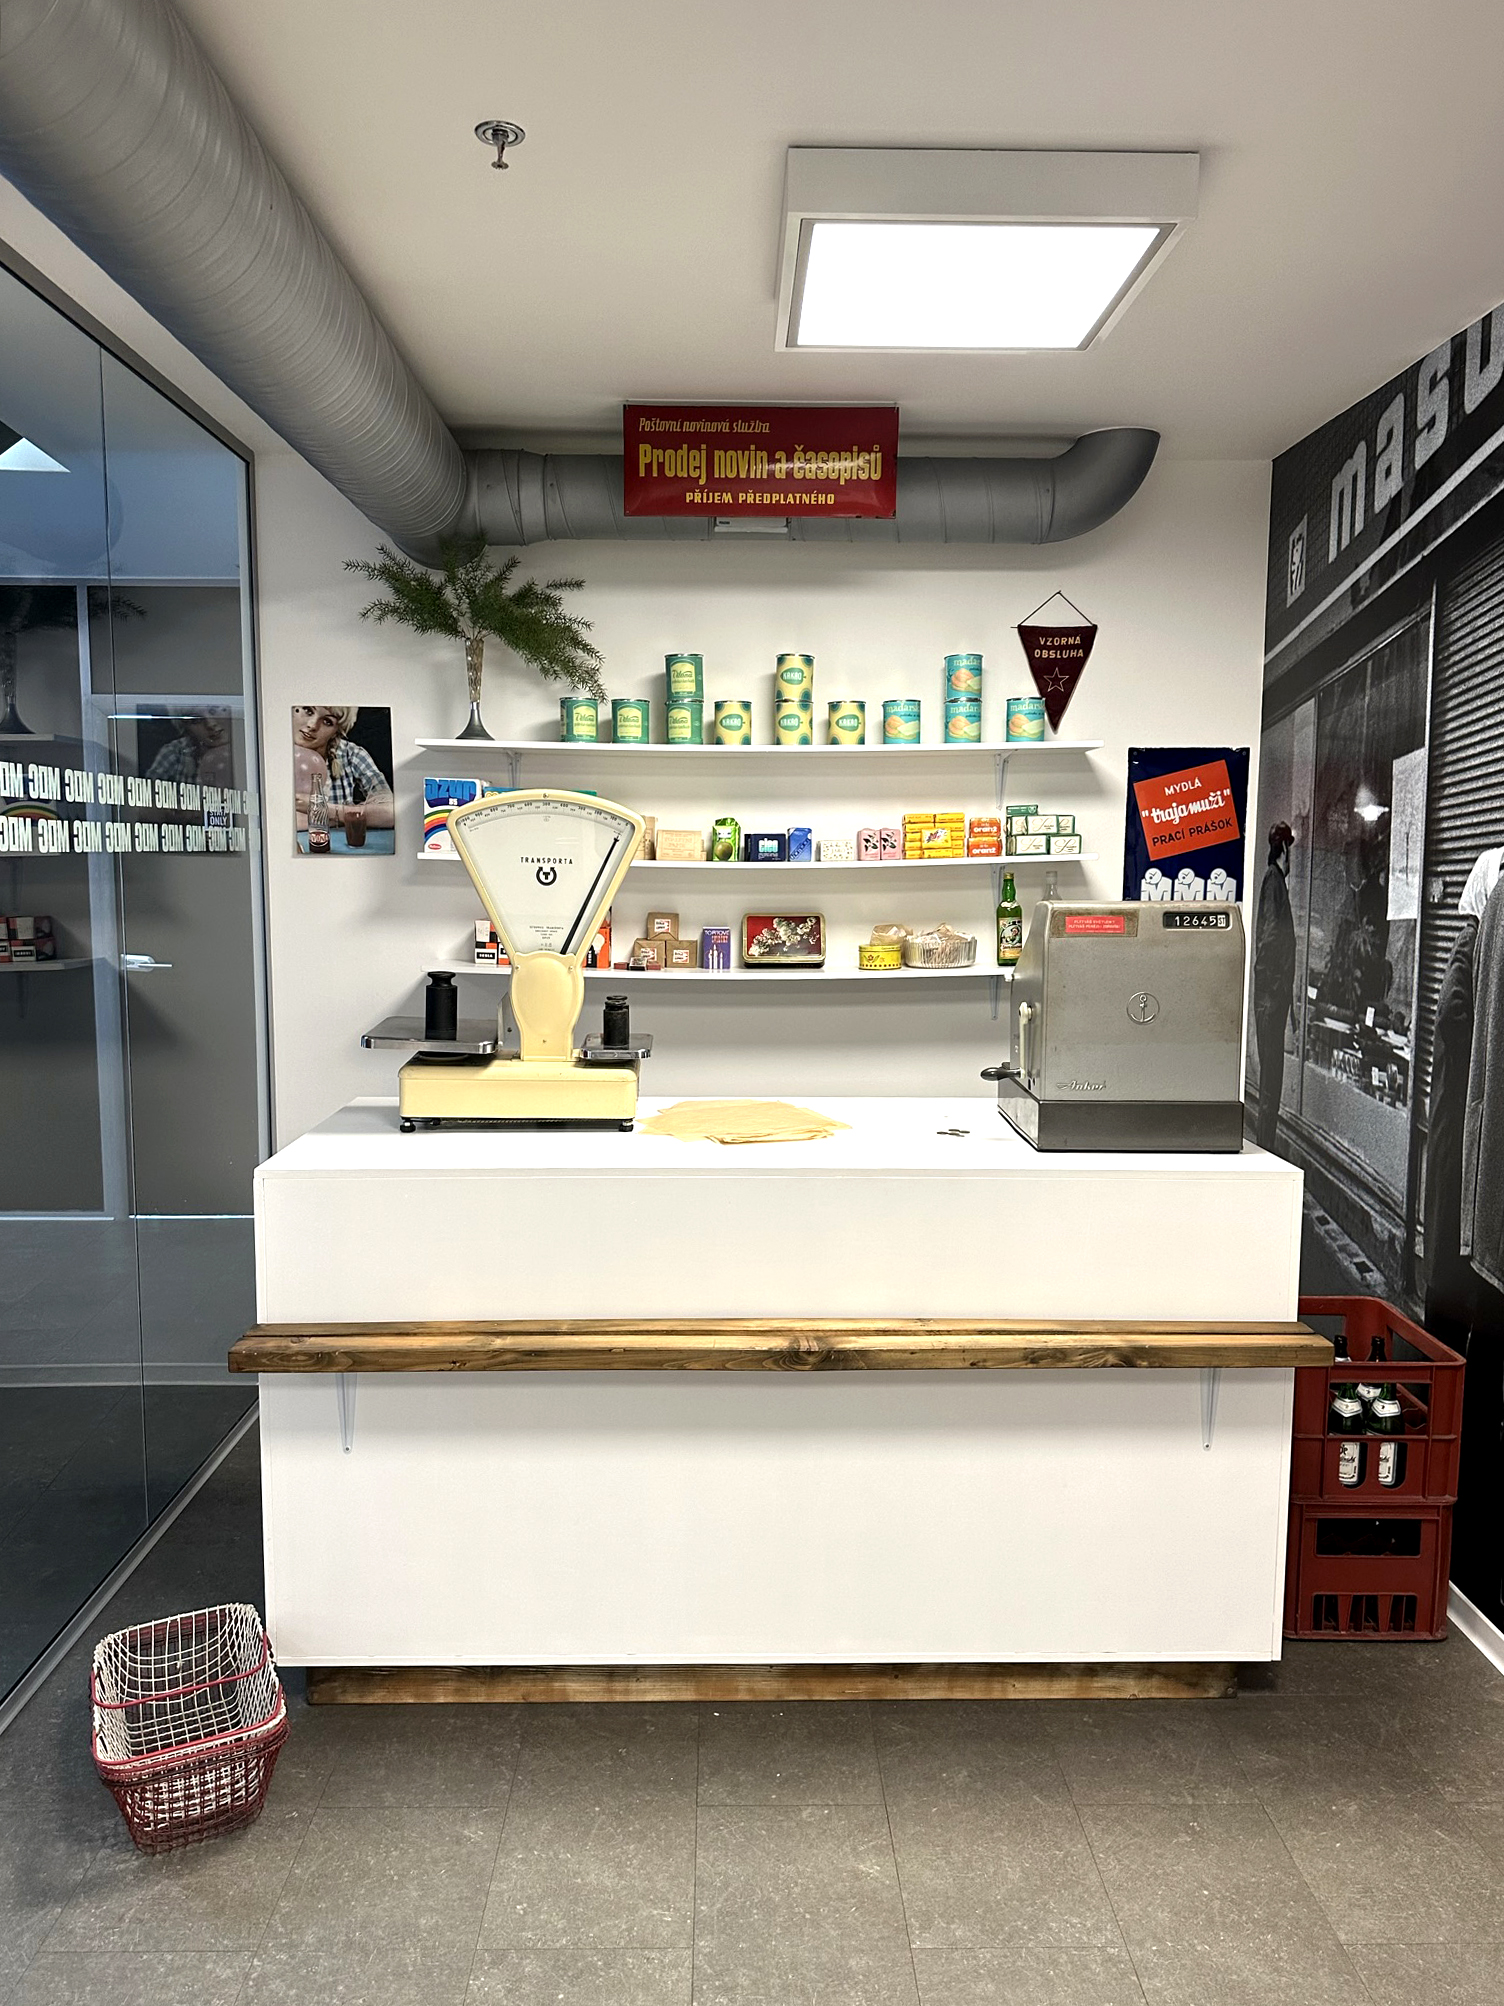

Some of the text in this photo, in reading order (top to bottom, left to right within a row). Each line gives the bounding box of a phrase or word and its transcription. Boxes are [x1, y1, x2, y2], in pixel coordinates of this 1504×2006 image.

[638, 417, 770, 433] Poštovní novinová služba
[638, 443, 882, 485] Prodej novin a časopisů
[685, 489, 835, 505] PŘÍJEM PŘEDPLATNÉHO
[1039, 634, 1081, 646] VZORNÁ
[1034, 649, 1084, 659] OBSLUHA
[782, 671, 802, 680] KAKAO
[425, 779, 477, 801] azur
[210, 817, 228, 826] ONLY
[1152, 817, 1233, 847] PRACÍ PRÁŠOK
[520, 857, 573, 865] TRANSPORTA
[1175, 915, 1217, 926] 12645
